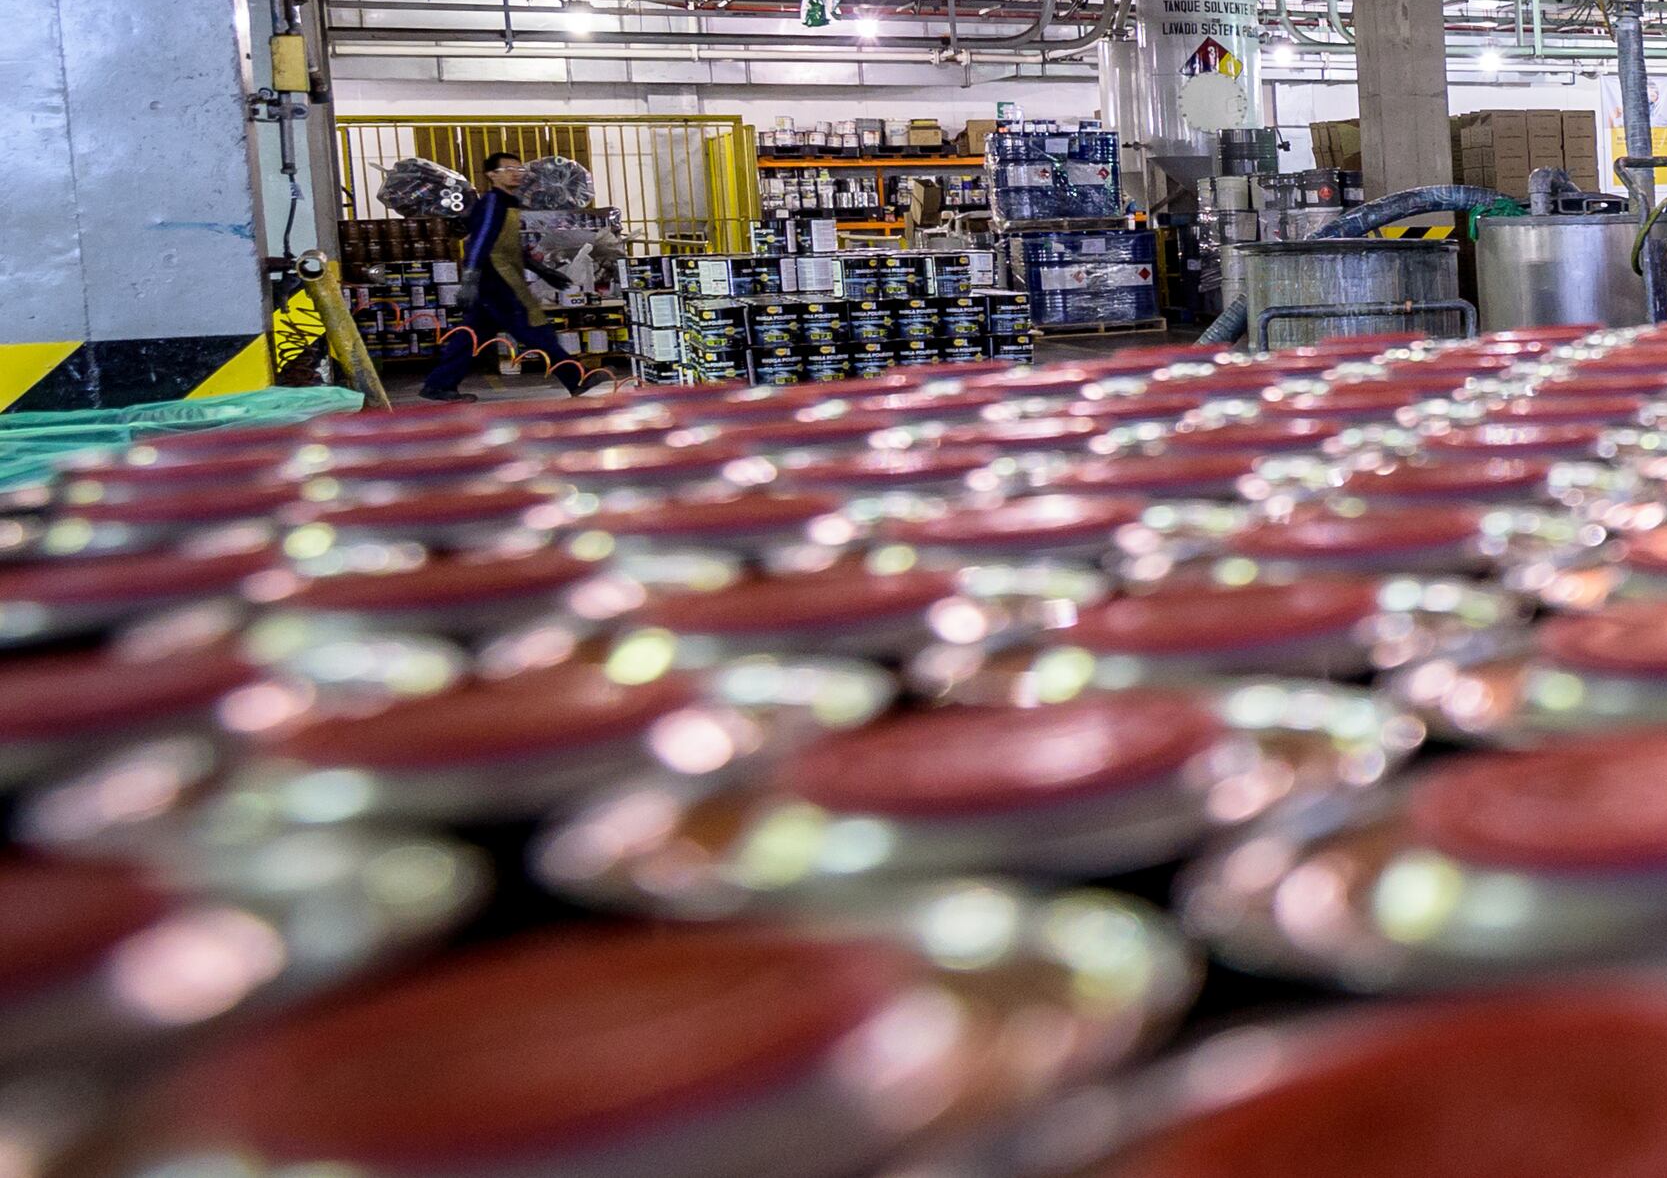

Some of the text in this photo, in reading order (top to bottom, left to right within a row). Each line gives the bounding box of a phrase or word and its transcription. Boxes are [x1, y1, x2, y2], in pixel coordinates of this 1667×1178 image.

[1163, 0, 1200, 13] TANQUE
[1204, 0, 1249, 16] SOLVENTE
[1162, 22, 1198, 35] LAVADO
